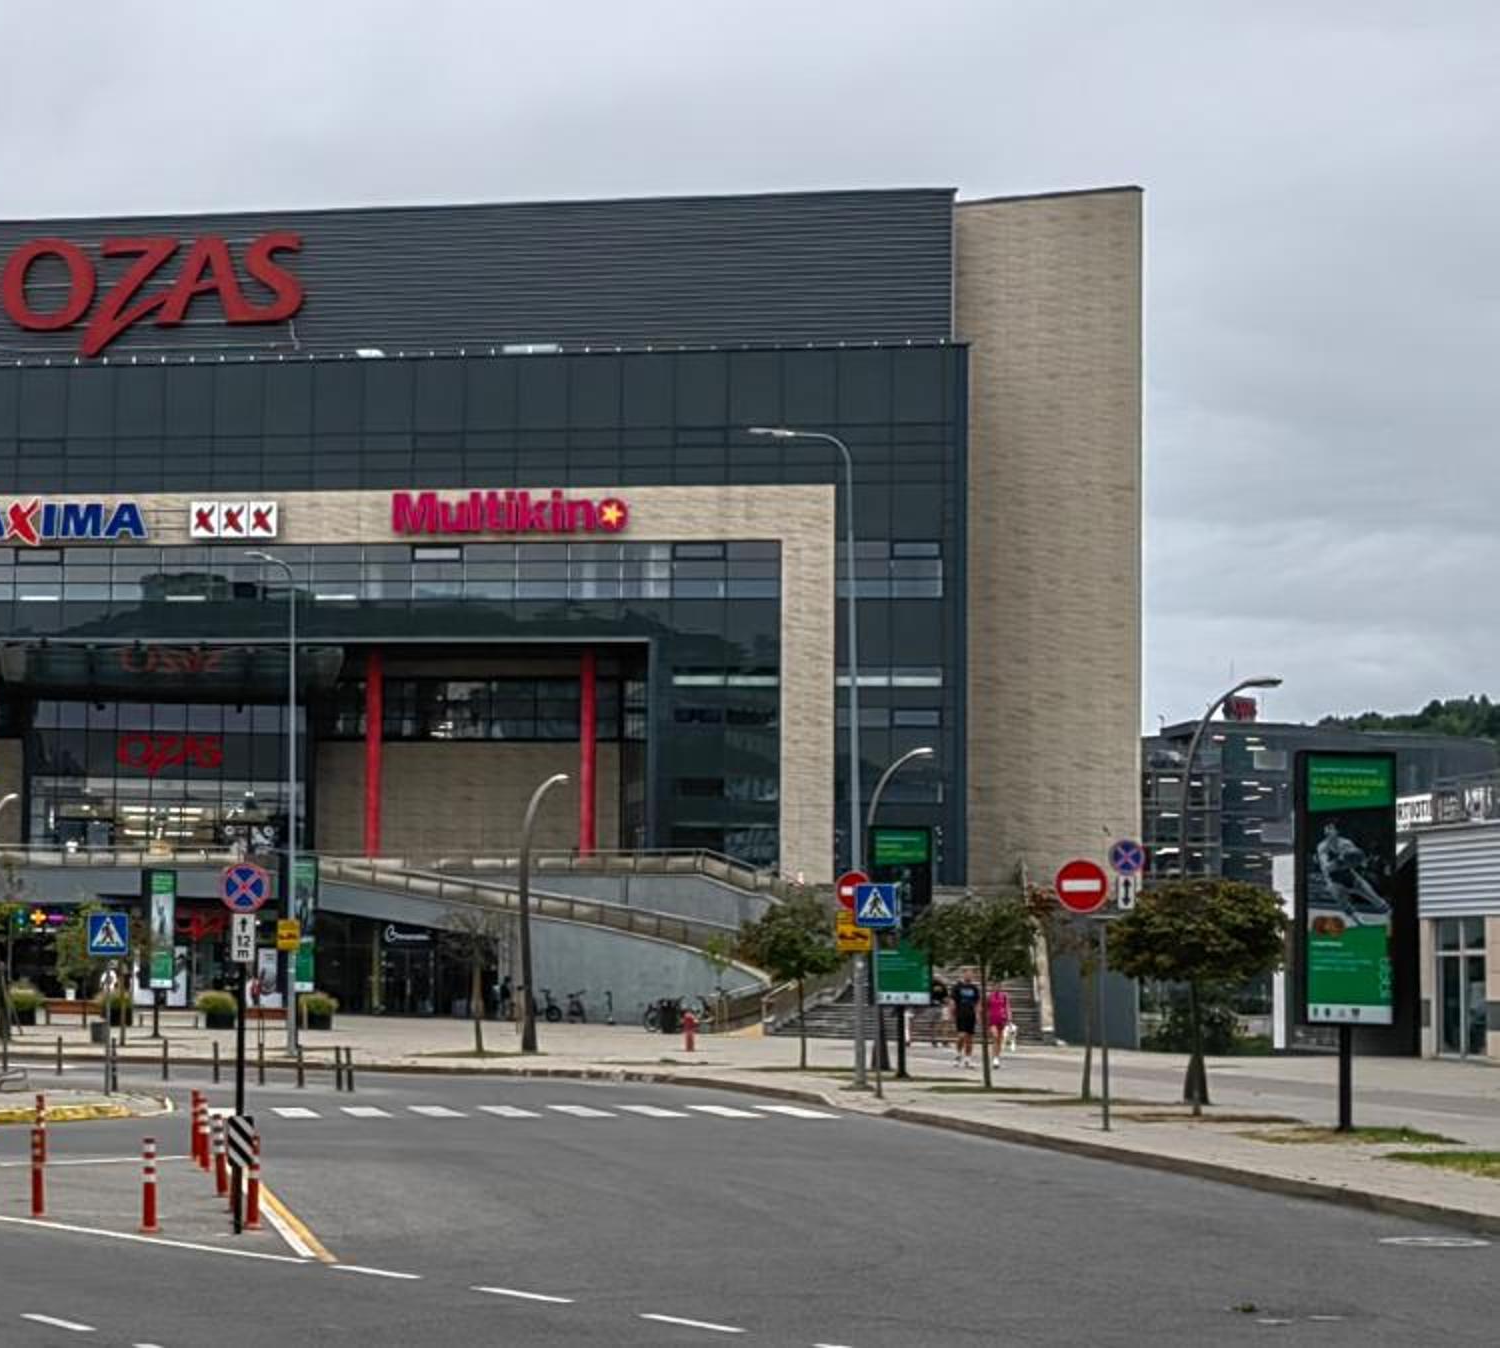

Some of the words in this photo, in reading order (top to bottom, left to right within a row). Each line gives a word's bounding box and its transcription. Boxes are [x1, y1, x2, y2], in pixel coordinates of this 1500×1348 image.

[0, 233, 304, 357] OZAS
[391, 489, 627, 533] Multikino
[115, 734, 225, 778] OZAS
[236, 935, 251, 948] 12
[236, 949, 249, 959] m
